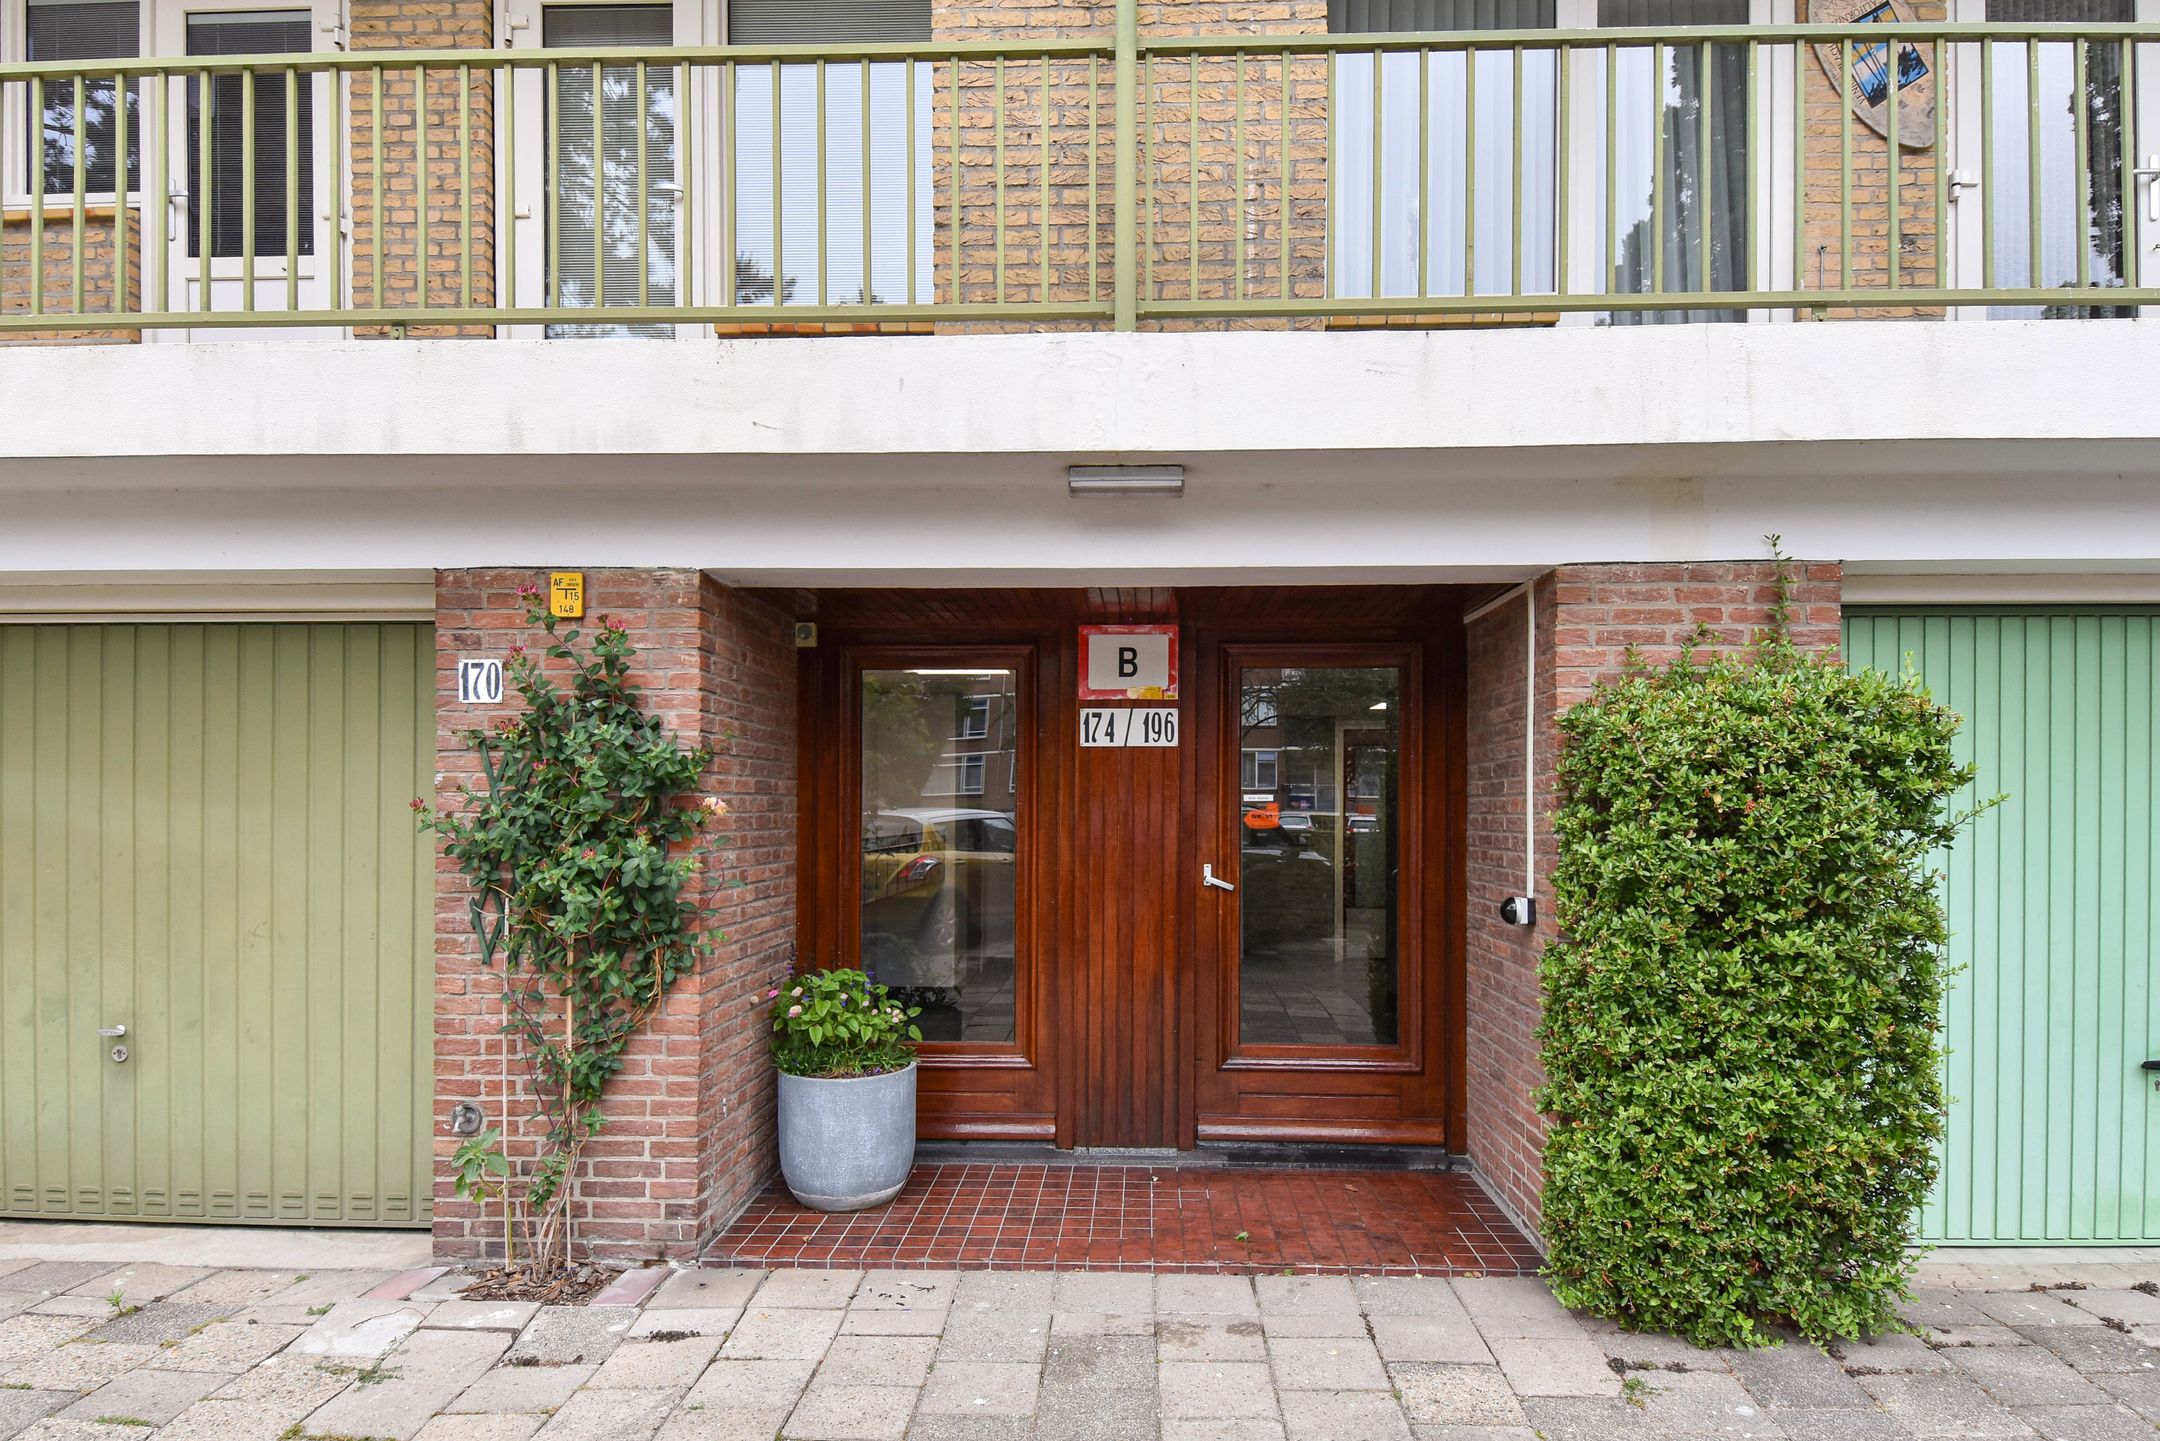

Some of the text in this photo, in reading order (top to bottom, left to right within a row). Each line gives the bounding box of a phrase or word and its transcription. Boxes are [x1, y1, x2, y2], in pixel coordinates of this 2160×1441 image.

[1831, 0, 1882, 23] ALIFORNI
[553, 578, 564, 586] AF
[1118, 647, 1138, 677] B
[461, 662, 501, 700] 170
